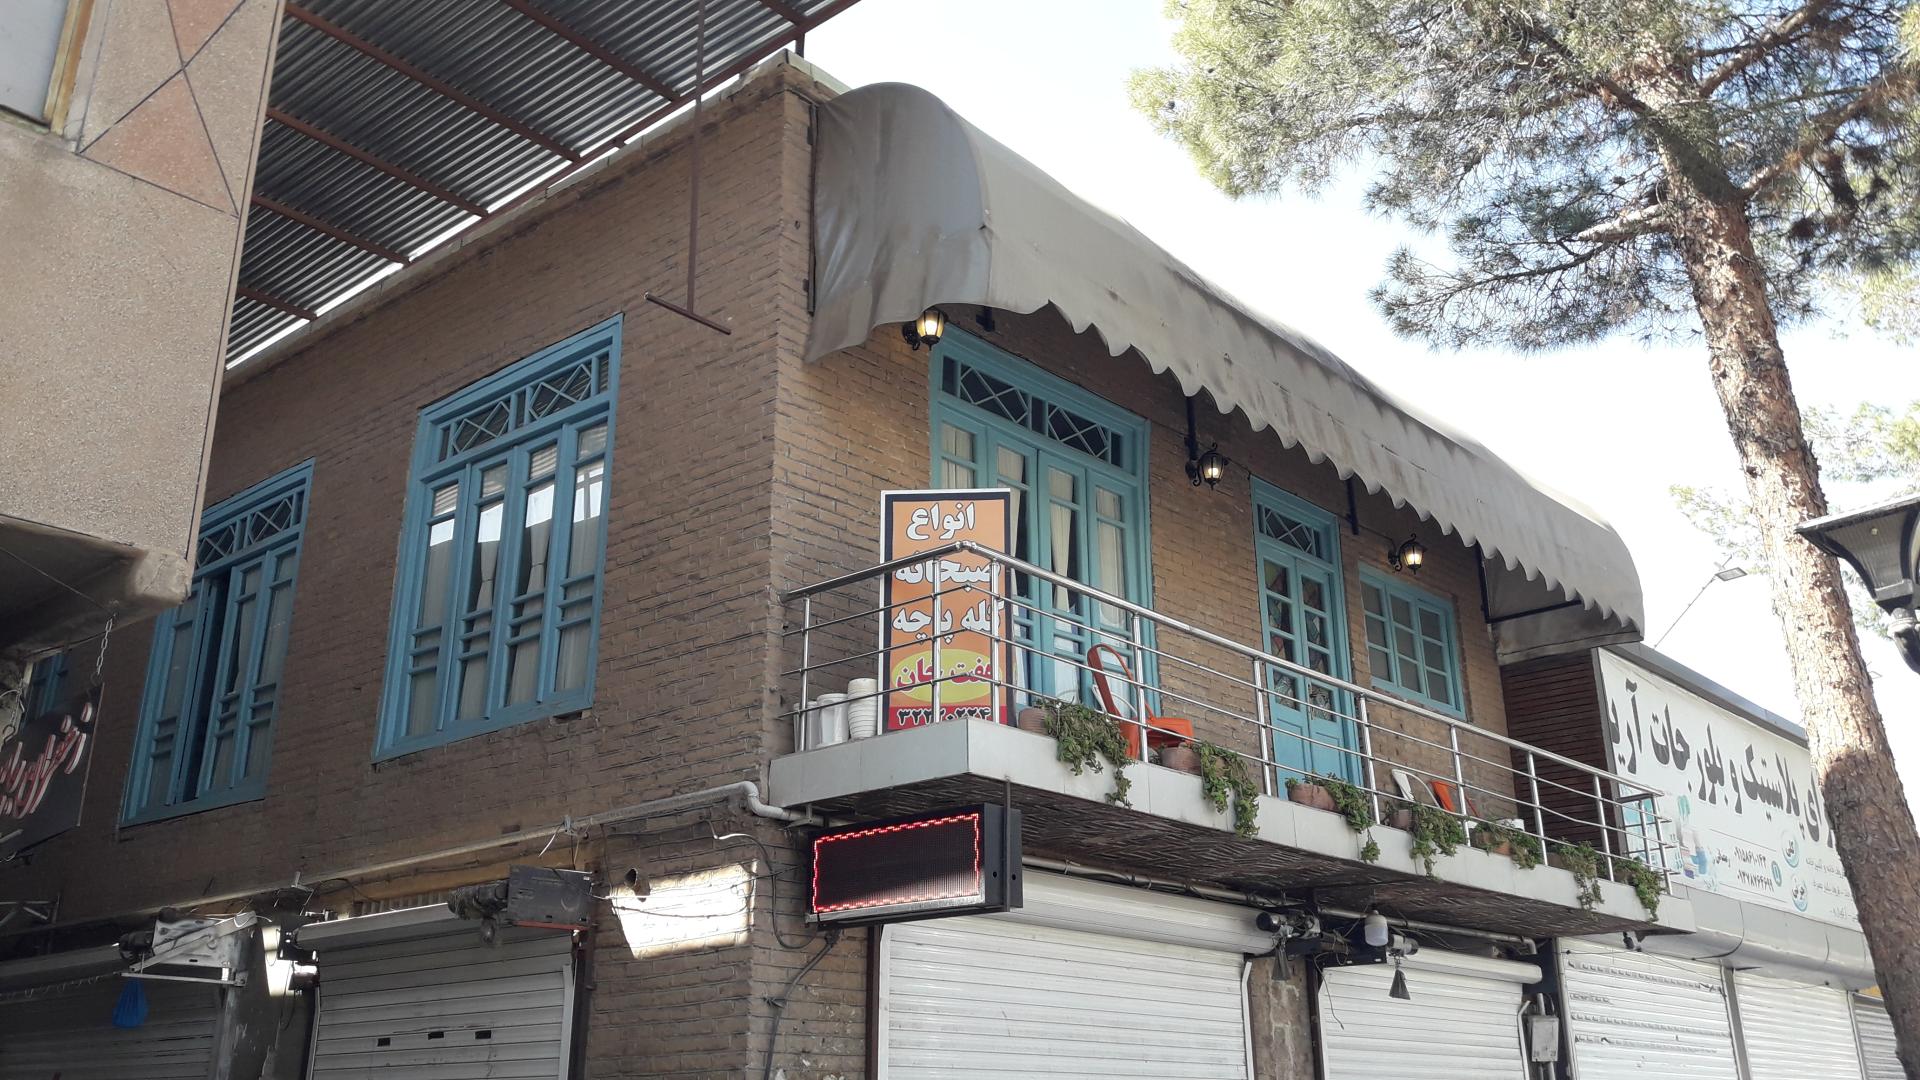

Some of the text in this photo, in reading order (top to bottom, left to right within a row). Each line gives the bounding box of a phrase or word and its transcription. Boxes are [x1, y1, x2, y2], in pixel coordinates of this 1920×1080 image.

[905, 502, 976, 541] انواع
[894, 550, 1001, 592] صبحانه
[892, 601, 953, 644] پچه
[1609, 678, 1643, 775] آری
[1730, 759, 1743, 815] و
[1740, 744, 1804, 841] پلاستیک
